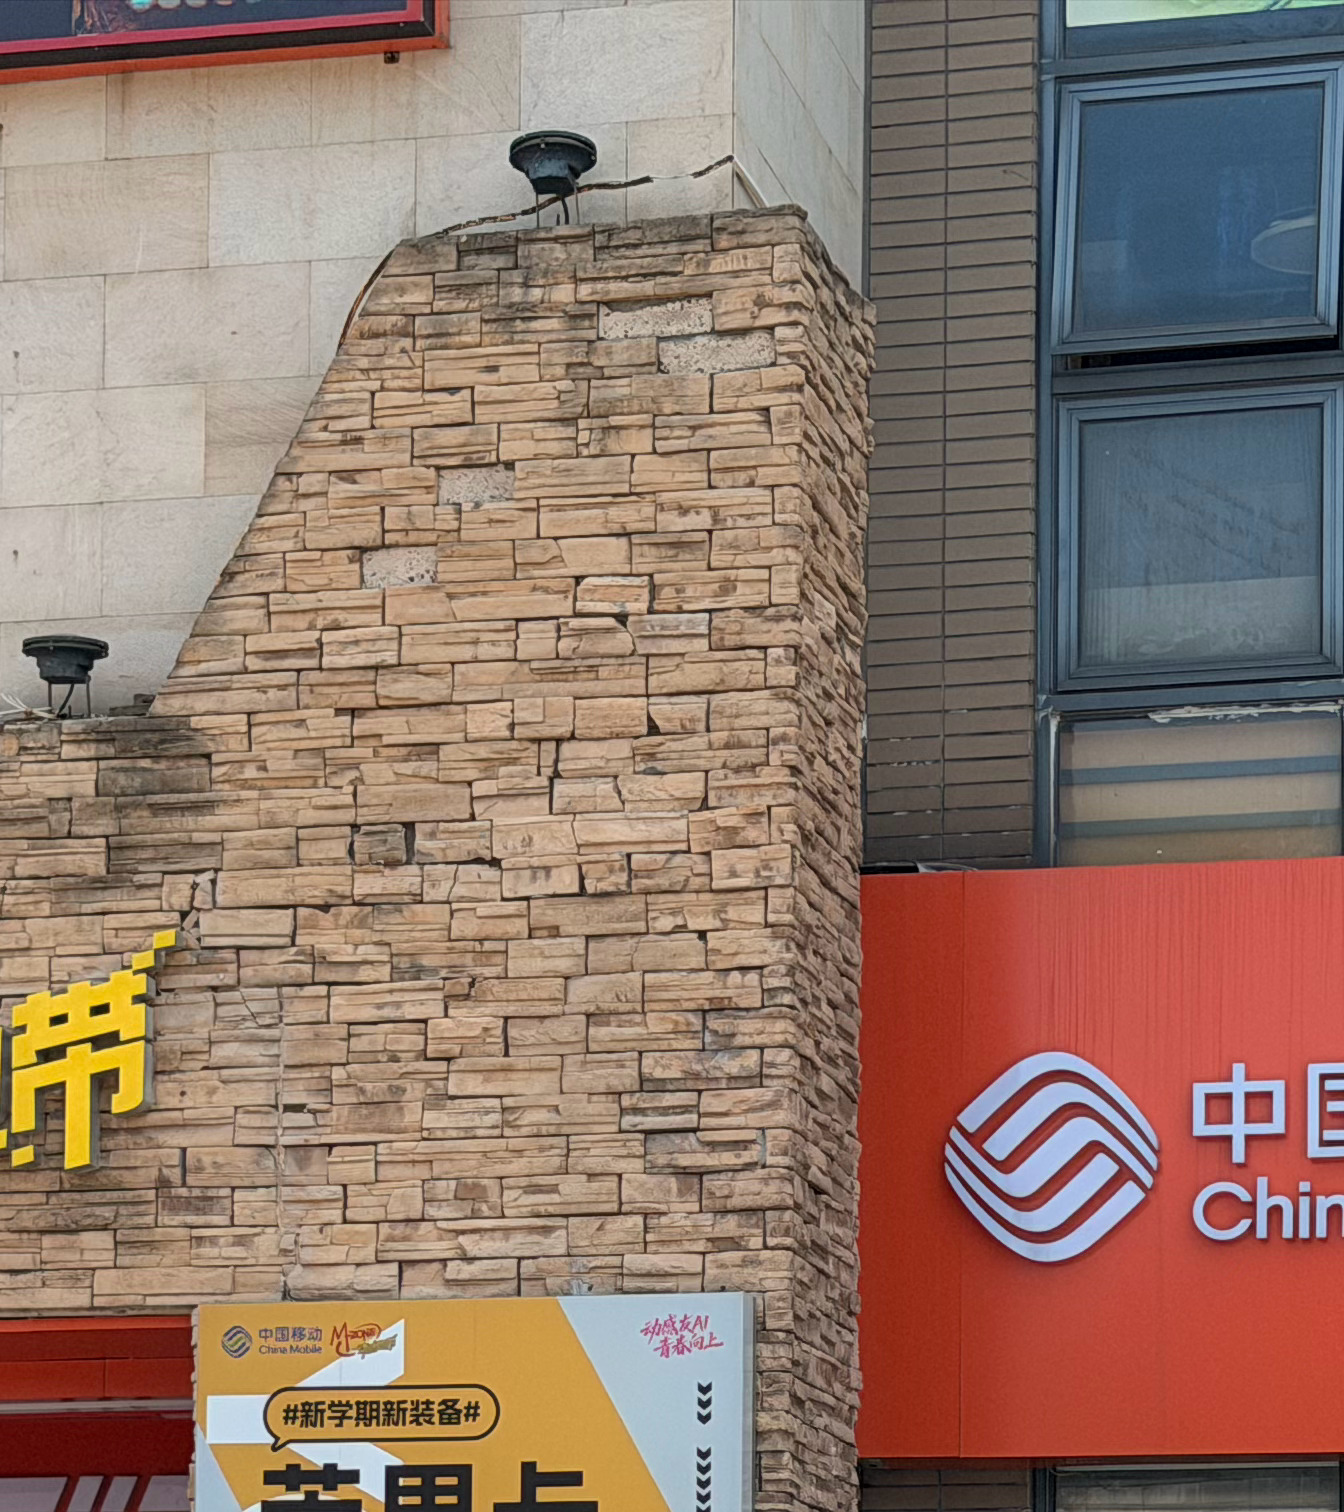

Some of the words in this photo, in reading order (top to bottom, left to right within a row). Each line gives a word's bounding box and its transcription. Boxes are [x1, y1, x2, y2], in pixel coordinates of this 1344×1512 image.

[259, 1326, 323, 1343] 中国移动
[259, 1344, 288, 1355] China
[289, 1344, 323, 1355] Mobile
[282, 1399, 482, 1428] #新学期新装备#
